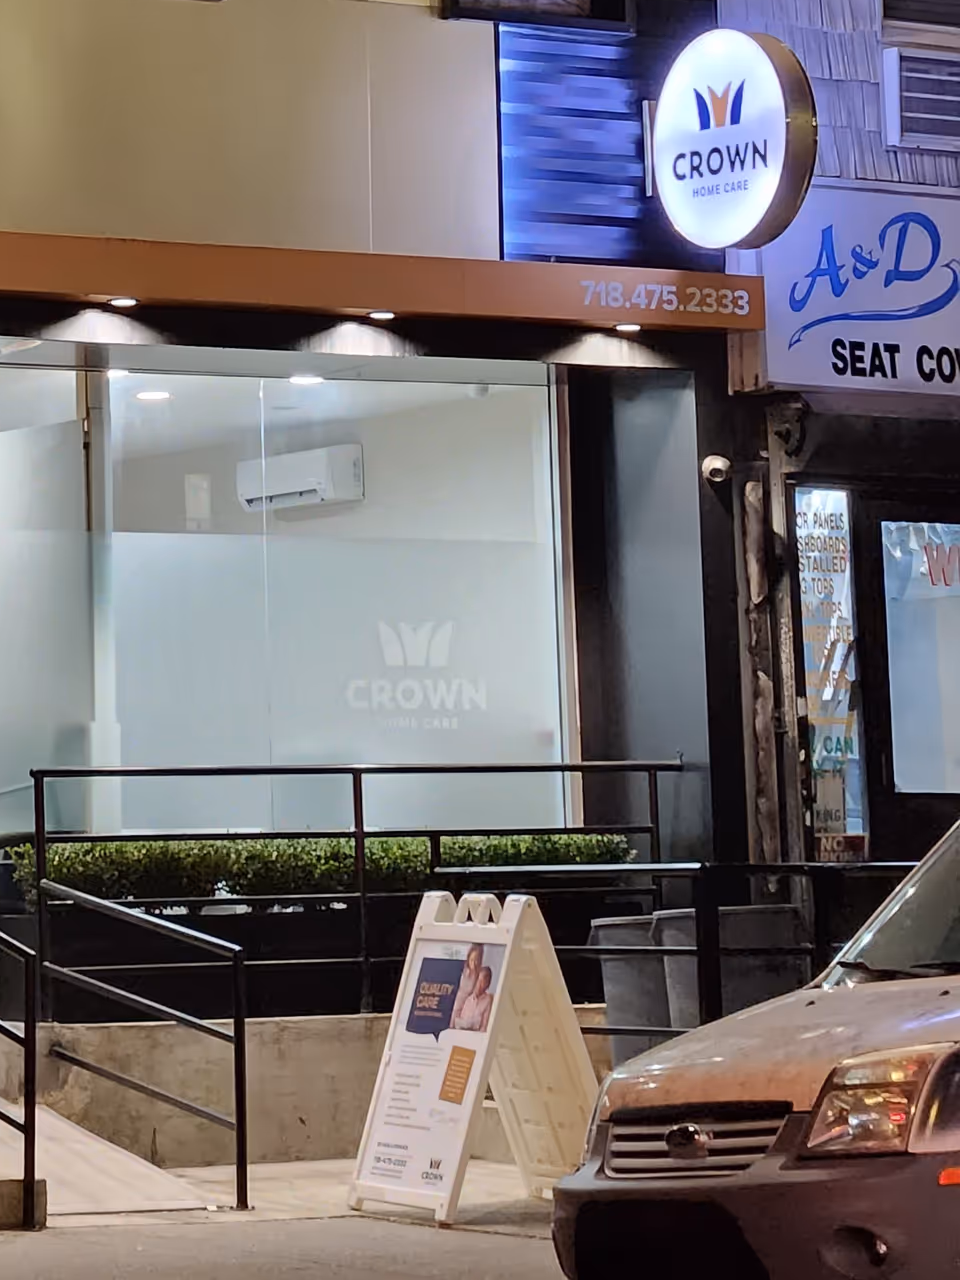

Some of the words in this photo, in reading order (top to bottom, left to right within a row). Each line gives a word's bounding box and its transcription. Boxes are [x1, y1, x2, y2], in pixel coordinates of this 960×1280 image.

[673, 138, 768, 181] CROWN
[692, 183, 721, 198] HOME
[723, 179, 749, 193] CARE
[580, 279, 749, 316] 718.475.2333
[831, 337, 900, 379] SEAT
[813, 512, 844, 530] PANELS
[346, 677, 488, 712] CROWN
[823, 735, 855, 755] CAN
[821, 836, 845, 851] NO
[420, 982, 455, 995] QUALITY
[416, 996, 440, 1009] CARE
